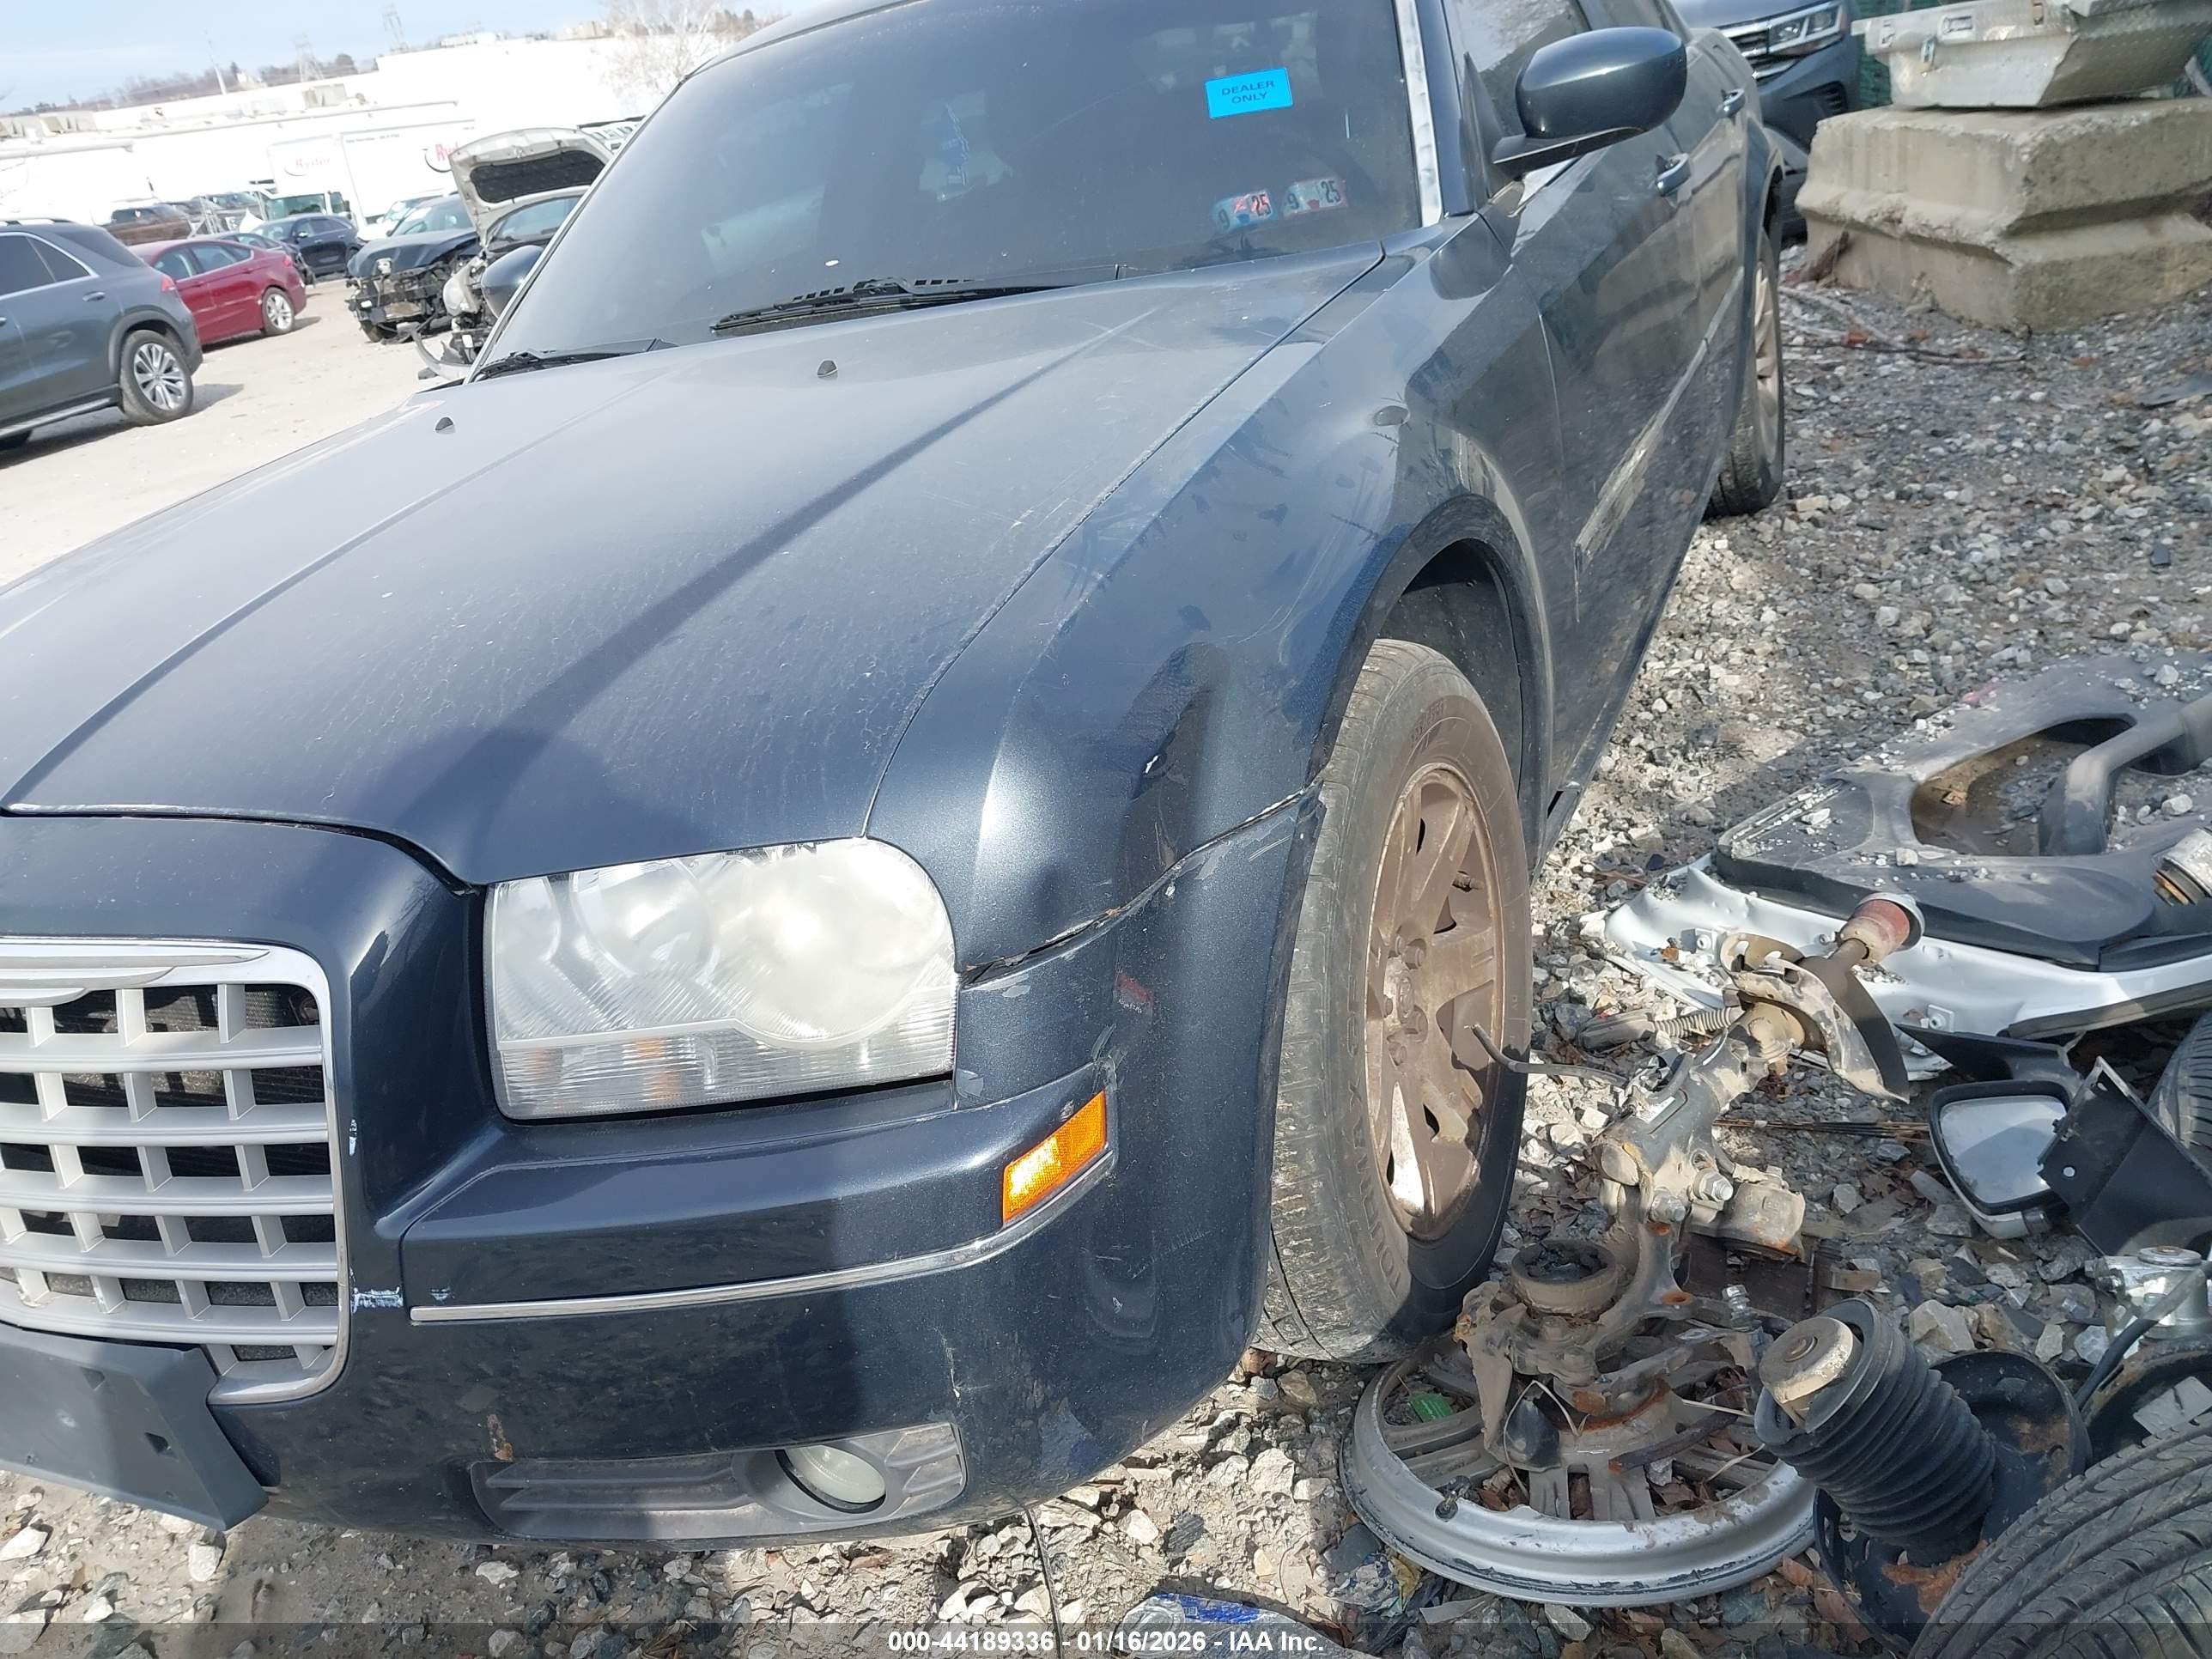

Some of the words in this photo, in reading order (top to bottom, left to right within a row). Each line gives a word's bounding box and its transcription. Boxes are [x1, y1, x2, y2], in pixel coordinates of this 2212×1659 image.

[1221, 81, 1274, 96] DEALER
[1231, 92, 1267, 104] ONLY
[1321, 180, 1341, 204] 25
[1251, 193, 1272, 216] 25
